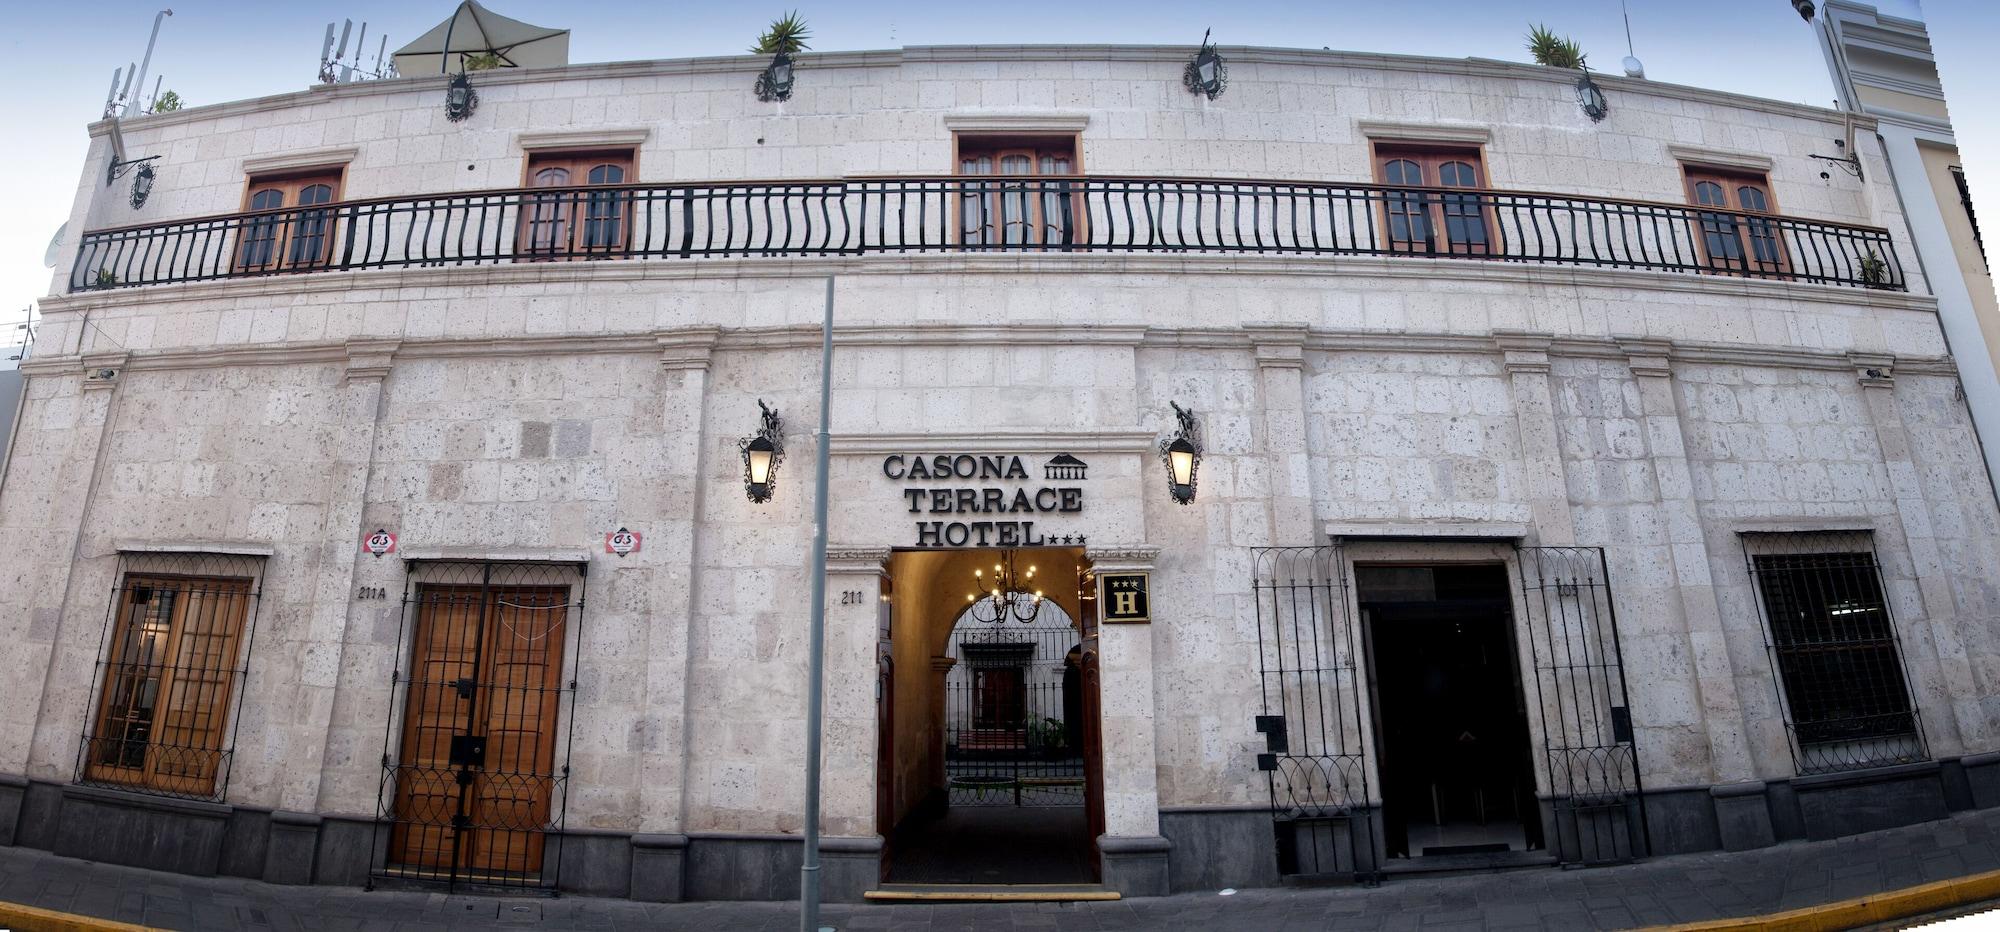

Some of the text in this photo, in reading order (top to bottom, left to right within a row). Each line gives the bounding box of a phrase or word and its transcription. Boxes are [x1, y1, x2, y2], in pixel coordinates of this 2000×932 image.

[883, 454, 1029, 480] CASONA
[904, 487, 1082, 513] TERRACE
[915, 521, 1045, 547] HOTEL
[358, 586, 386, 600] 211A
[841, 590, 862, 605] 211
[1113, 591, 1139, 615] H
